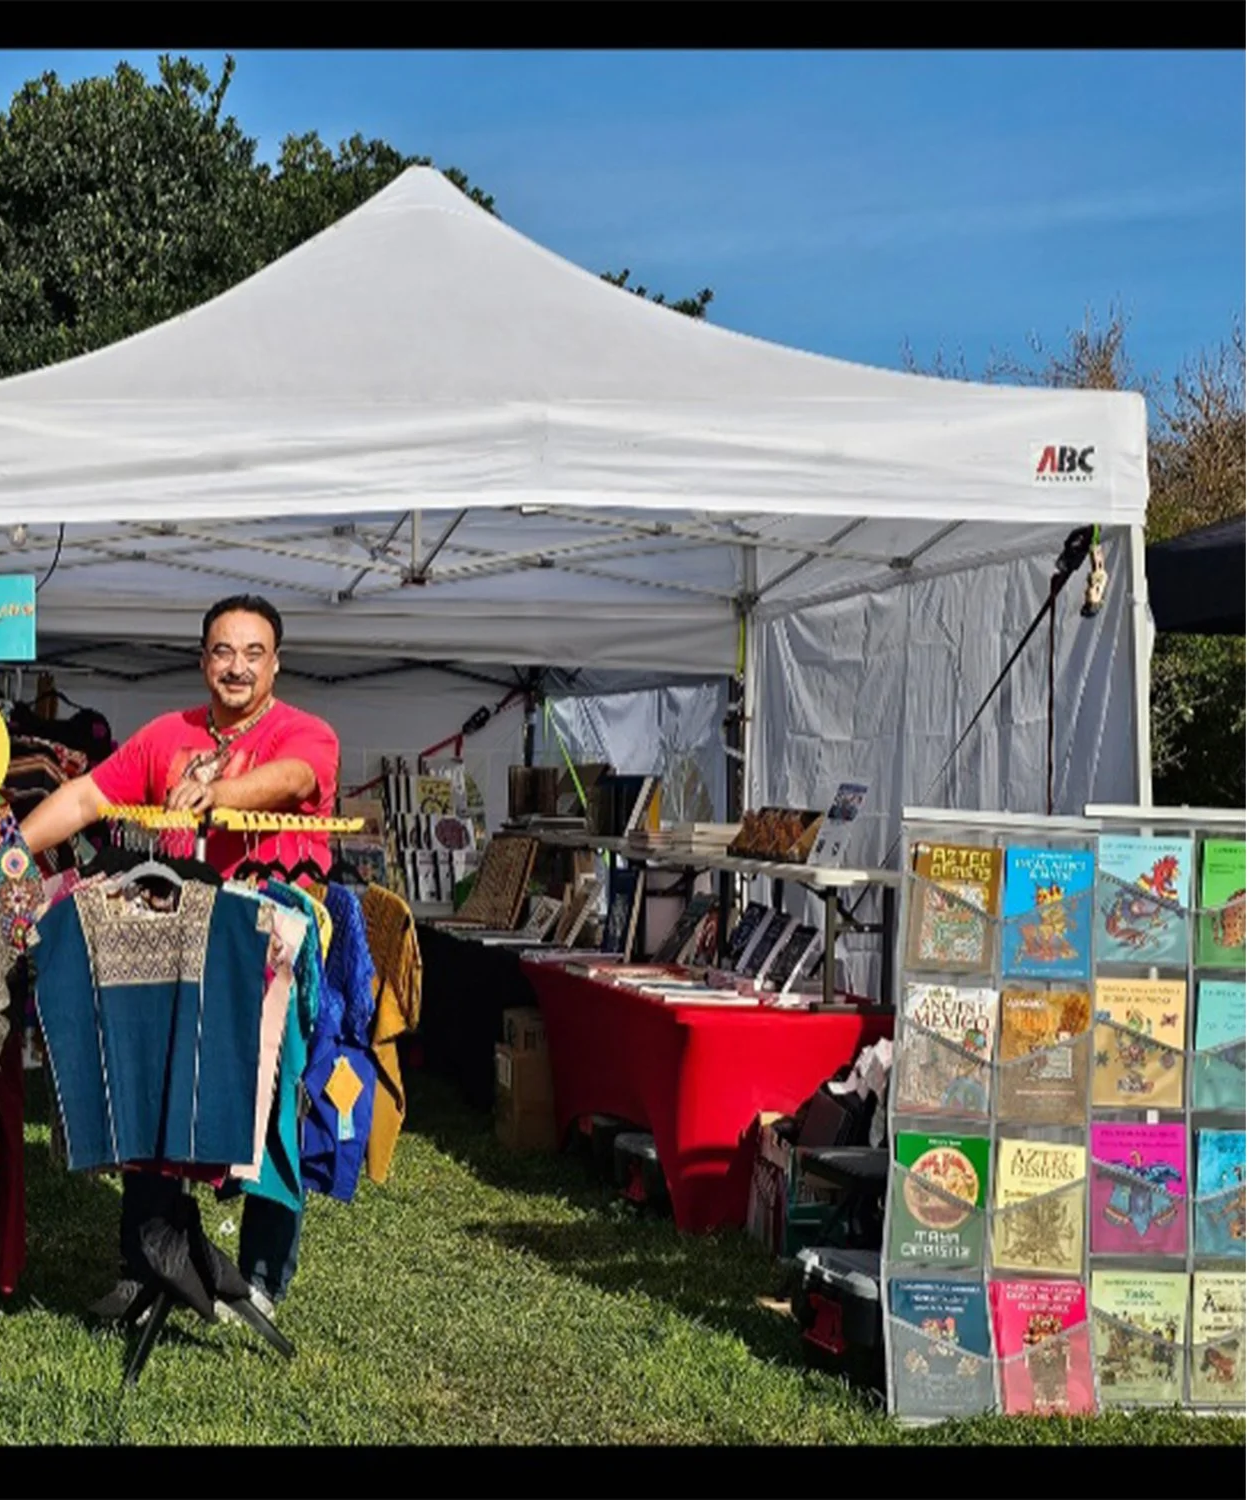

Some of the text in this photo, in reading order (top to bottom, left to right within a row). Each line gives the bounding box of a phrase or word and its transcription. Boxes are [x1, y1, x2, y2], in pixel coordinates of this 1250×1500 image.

[1036, 446, 1094, 473] ABC
[913, 1009, 989, 1031] MEXICO
[1013, 1148, 1077, 1168] AZTEC
